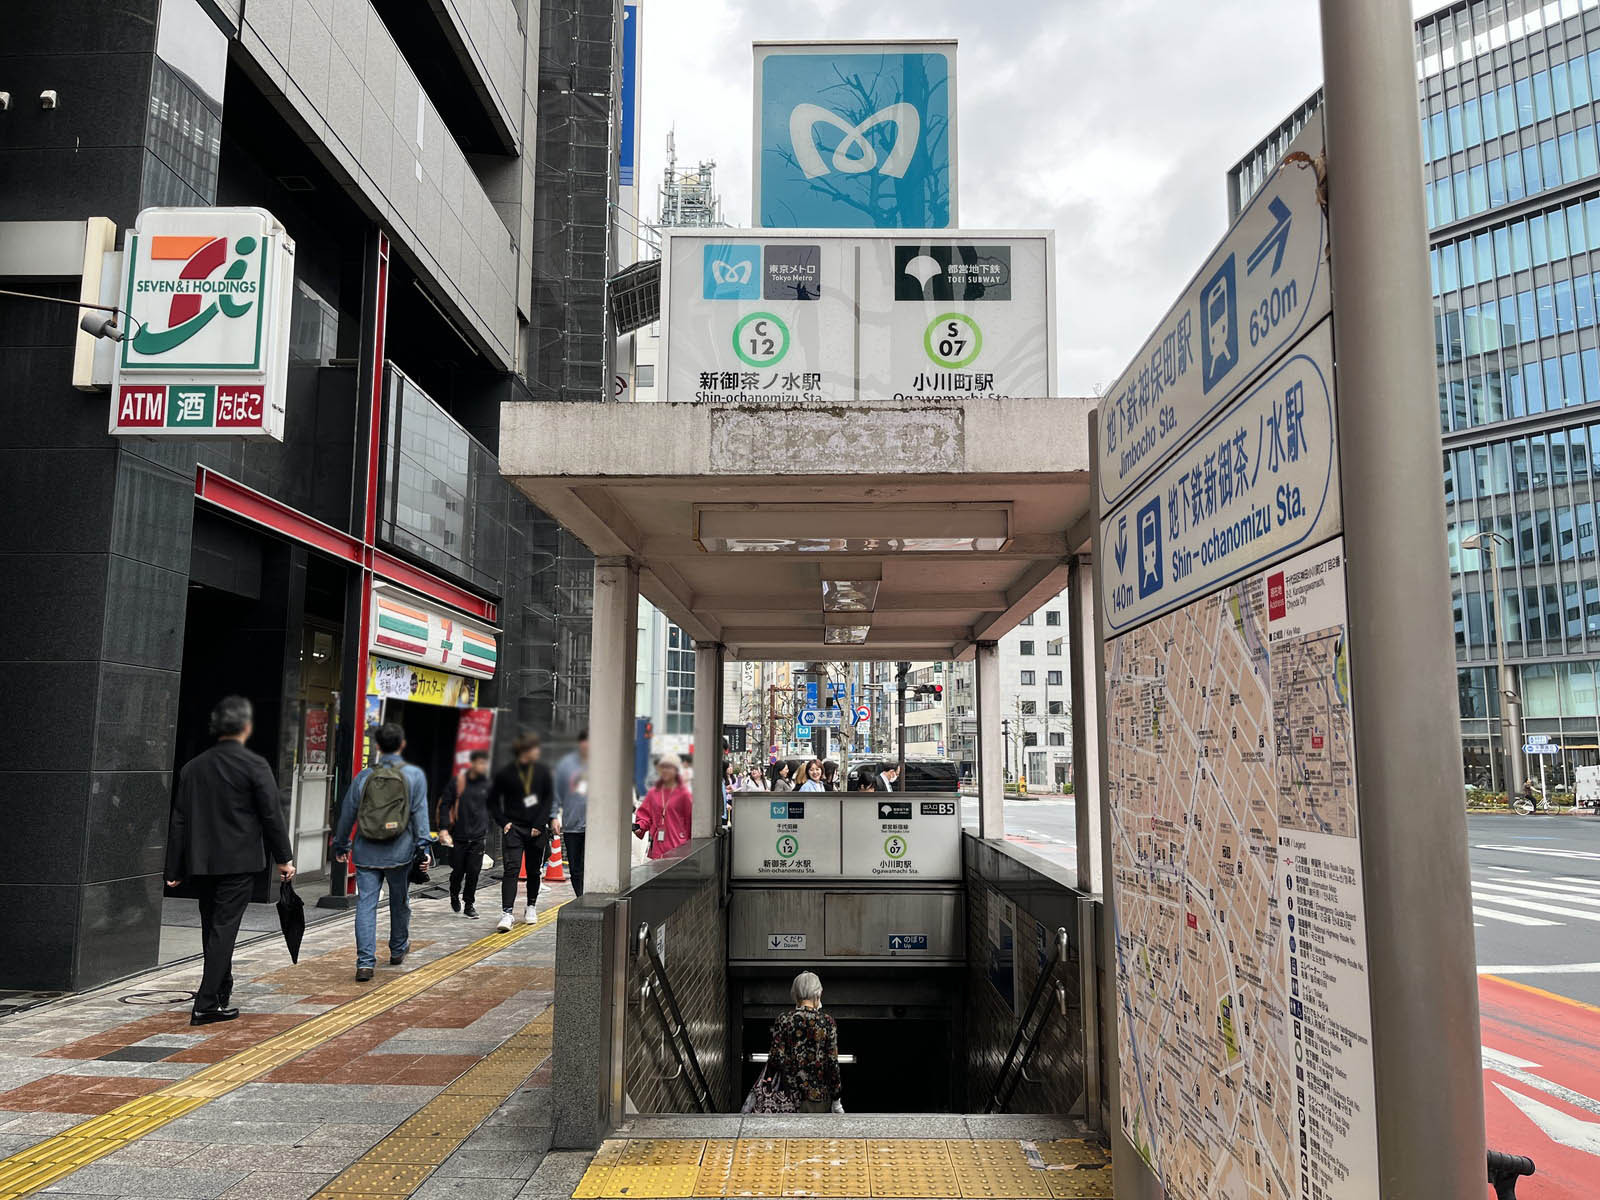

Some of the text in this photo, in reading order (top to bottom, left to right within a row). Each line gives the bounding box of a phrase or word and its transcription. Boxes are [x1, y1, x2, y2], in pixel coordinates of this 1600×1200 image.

[768, 264, 816, 274] 東京メトロ
[772, 274, 790, 282] Tokyo
[948, 264, 1000, 274] 都営地下鉄
[193, 280, 256, 294] HOLDINGS
[1250, 279, 1297, 347] 630m
[754, 322, 767, 337] C
[948, 322, 958, 338] S
[750, 339, 775, 356] 12
[938, 340, 967, 357] 07
[699, 372, 822, 390] 新御茶ノ水駅
[913, 373, 994, 392] 小川町駅
[1107, 308, 1194, 456] 地下鉄神保町駅
[120, 392, 163, 420] ATM
[176, 392, 206, 422] 酒
[218, 392, 262, 420] たばこ
[1120, 406, 1177, 480] Jimbocho Sta.
[1168, 380, 1308, 542] 地下鉄新御茶ノ水駅
[1277, 482, 1306, 526] Sta.
[1112, 582, 1134, 614] 140m
[939, 804, 953, 814] B5
